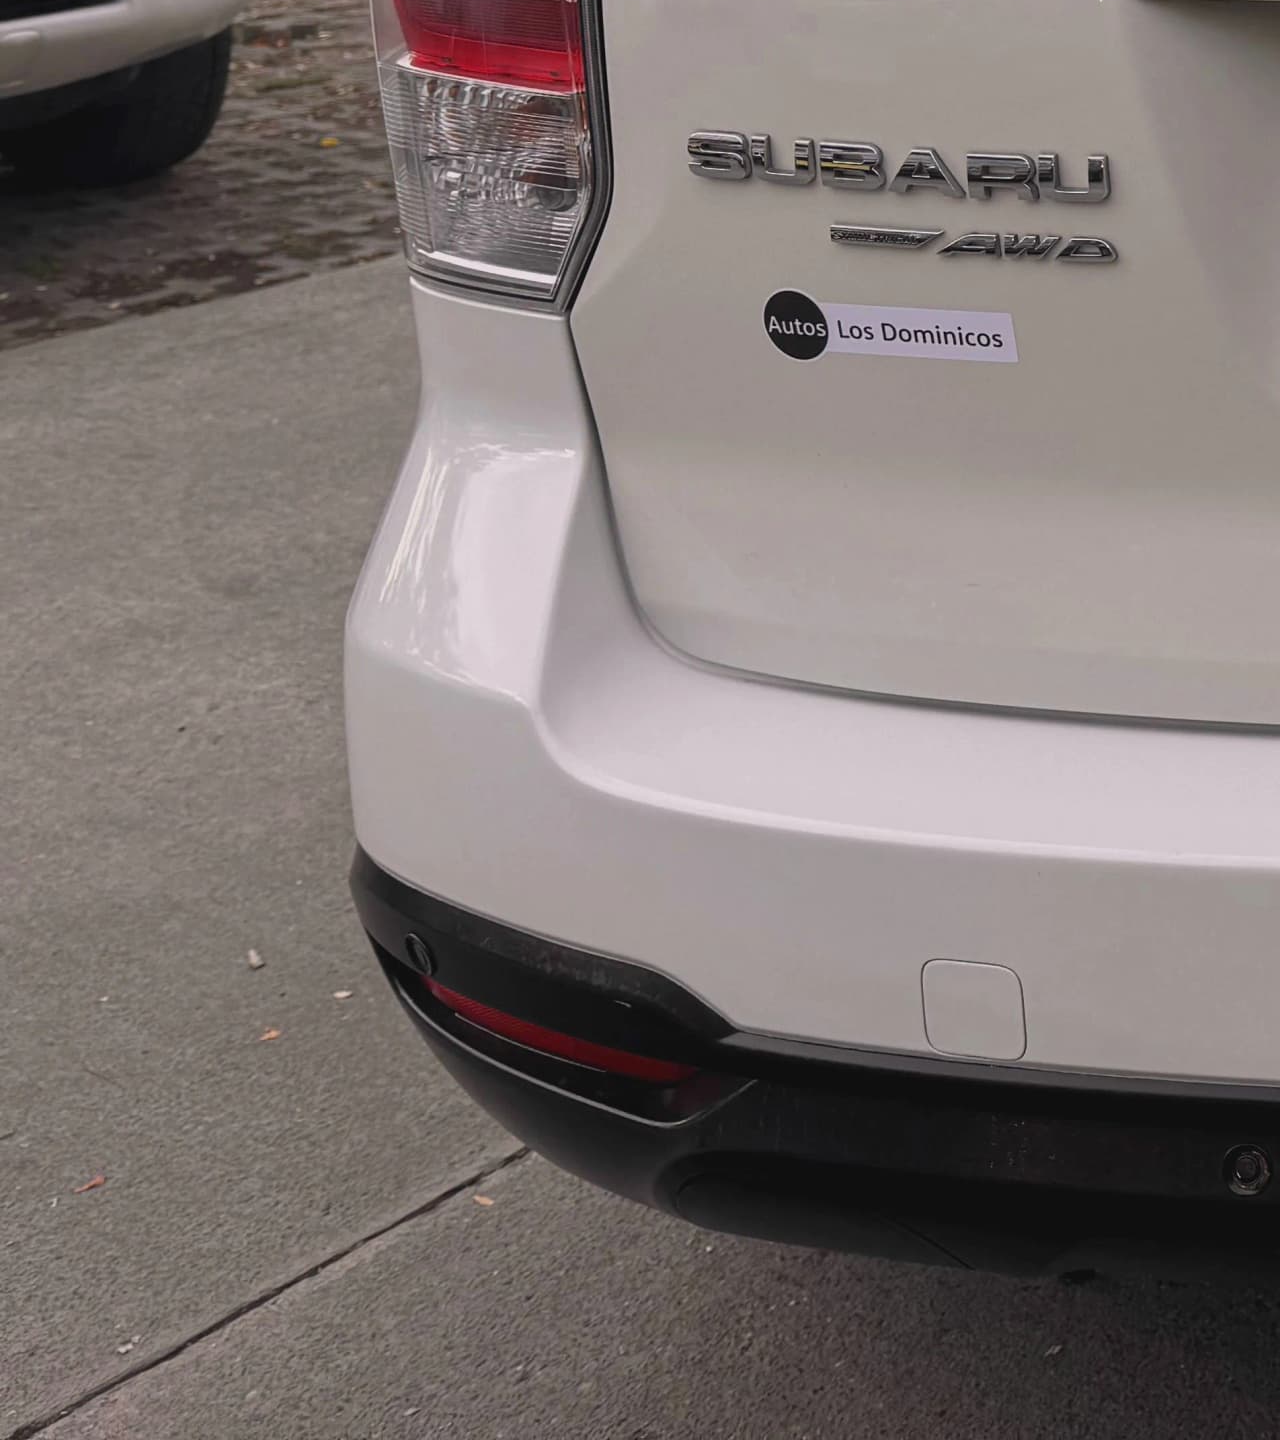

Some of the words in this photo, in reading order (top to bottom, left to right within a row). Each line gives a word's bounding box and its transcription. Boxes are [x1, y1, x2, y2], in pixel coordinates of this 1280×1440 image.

[687, 129, 1112, 203] SUBARU
[936, 232, 1119, 262] AWD
[767, 314, 827, 338] Autos
[837, 318, 875, 342] Los
[881, 321, 1004, 350] Dominicos
